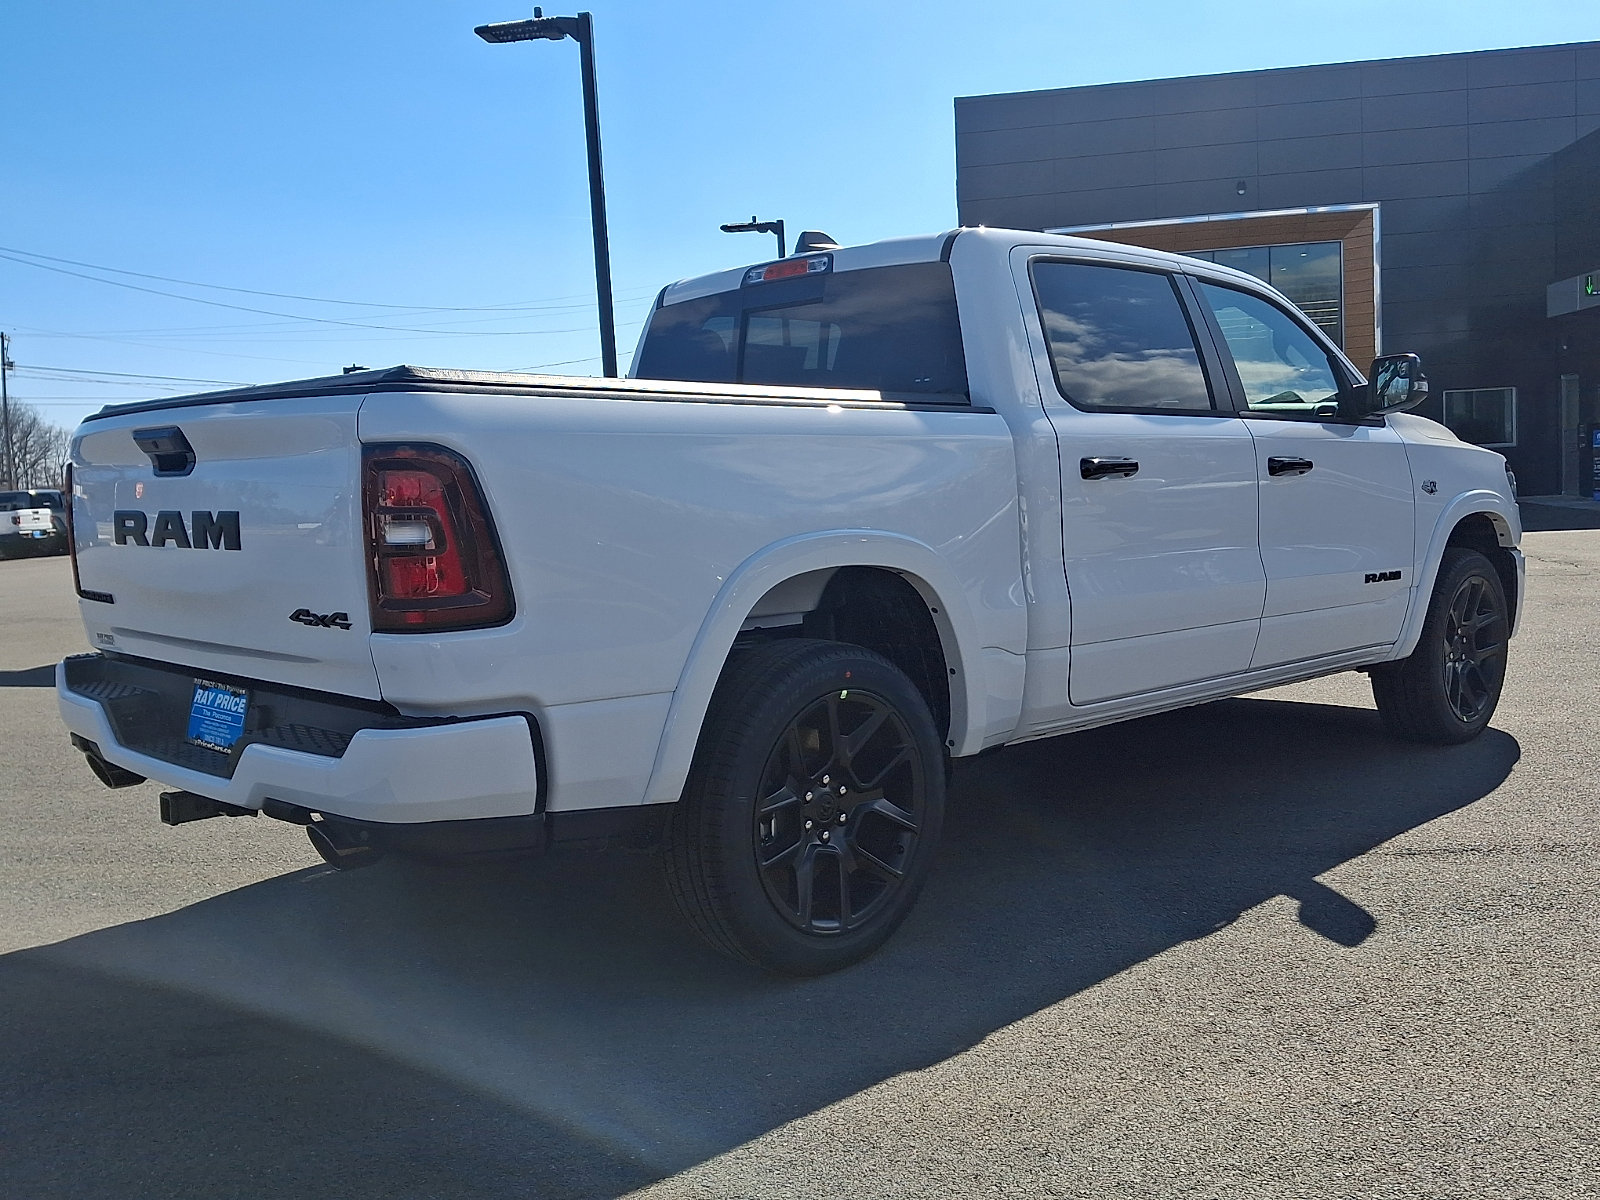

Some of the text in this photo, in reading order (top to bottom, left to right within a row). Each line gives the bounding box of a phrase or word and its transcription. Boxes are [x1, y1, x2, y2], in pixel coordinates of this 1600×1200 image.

[114, 510, 242, 551] RAM
[1364, 570, 1402, 584] RAM
[194, 689, 247, 713] RAY PRICE
[203, 708, 211, 716] The
